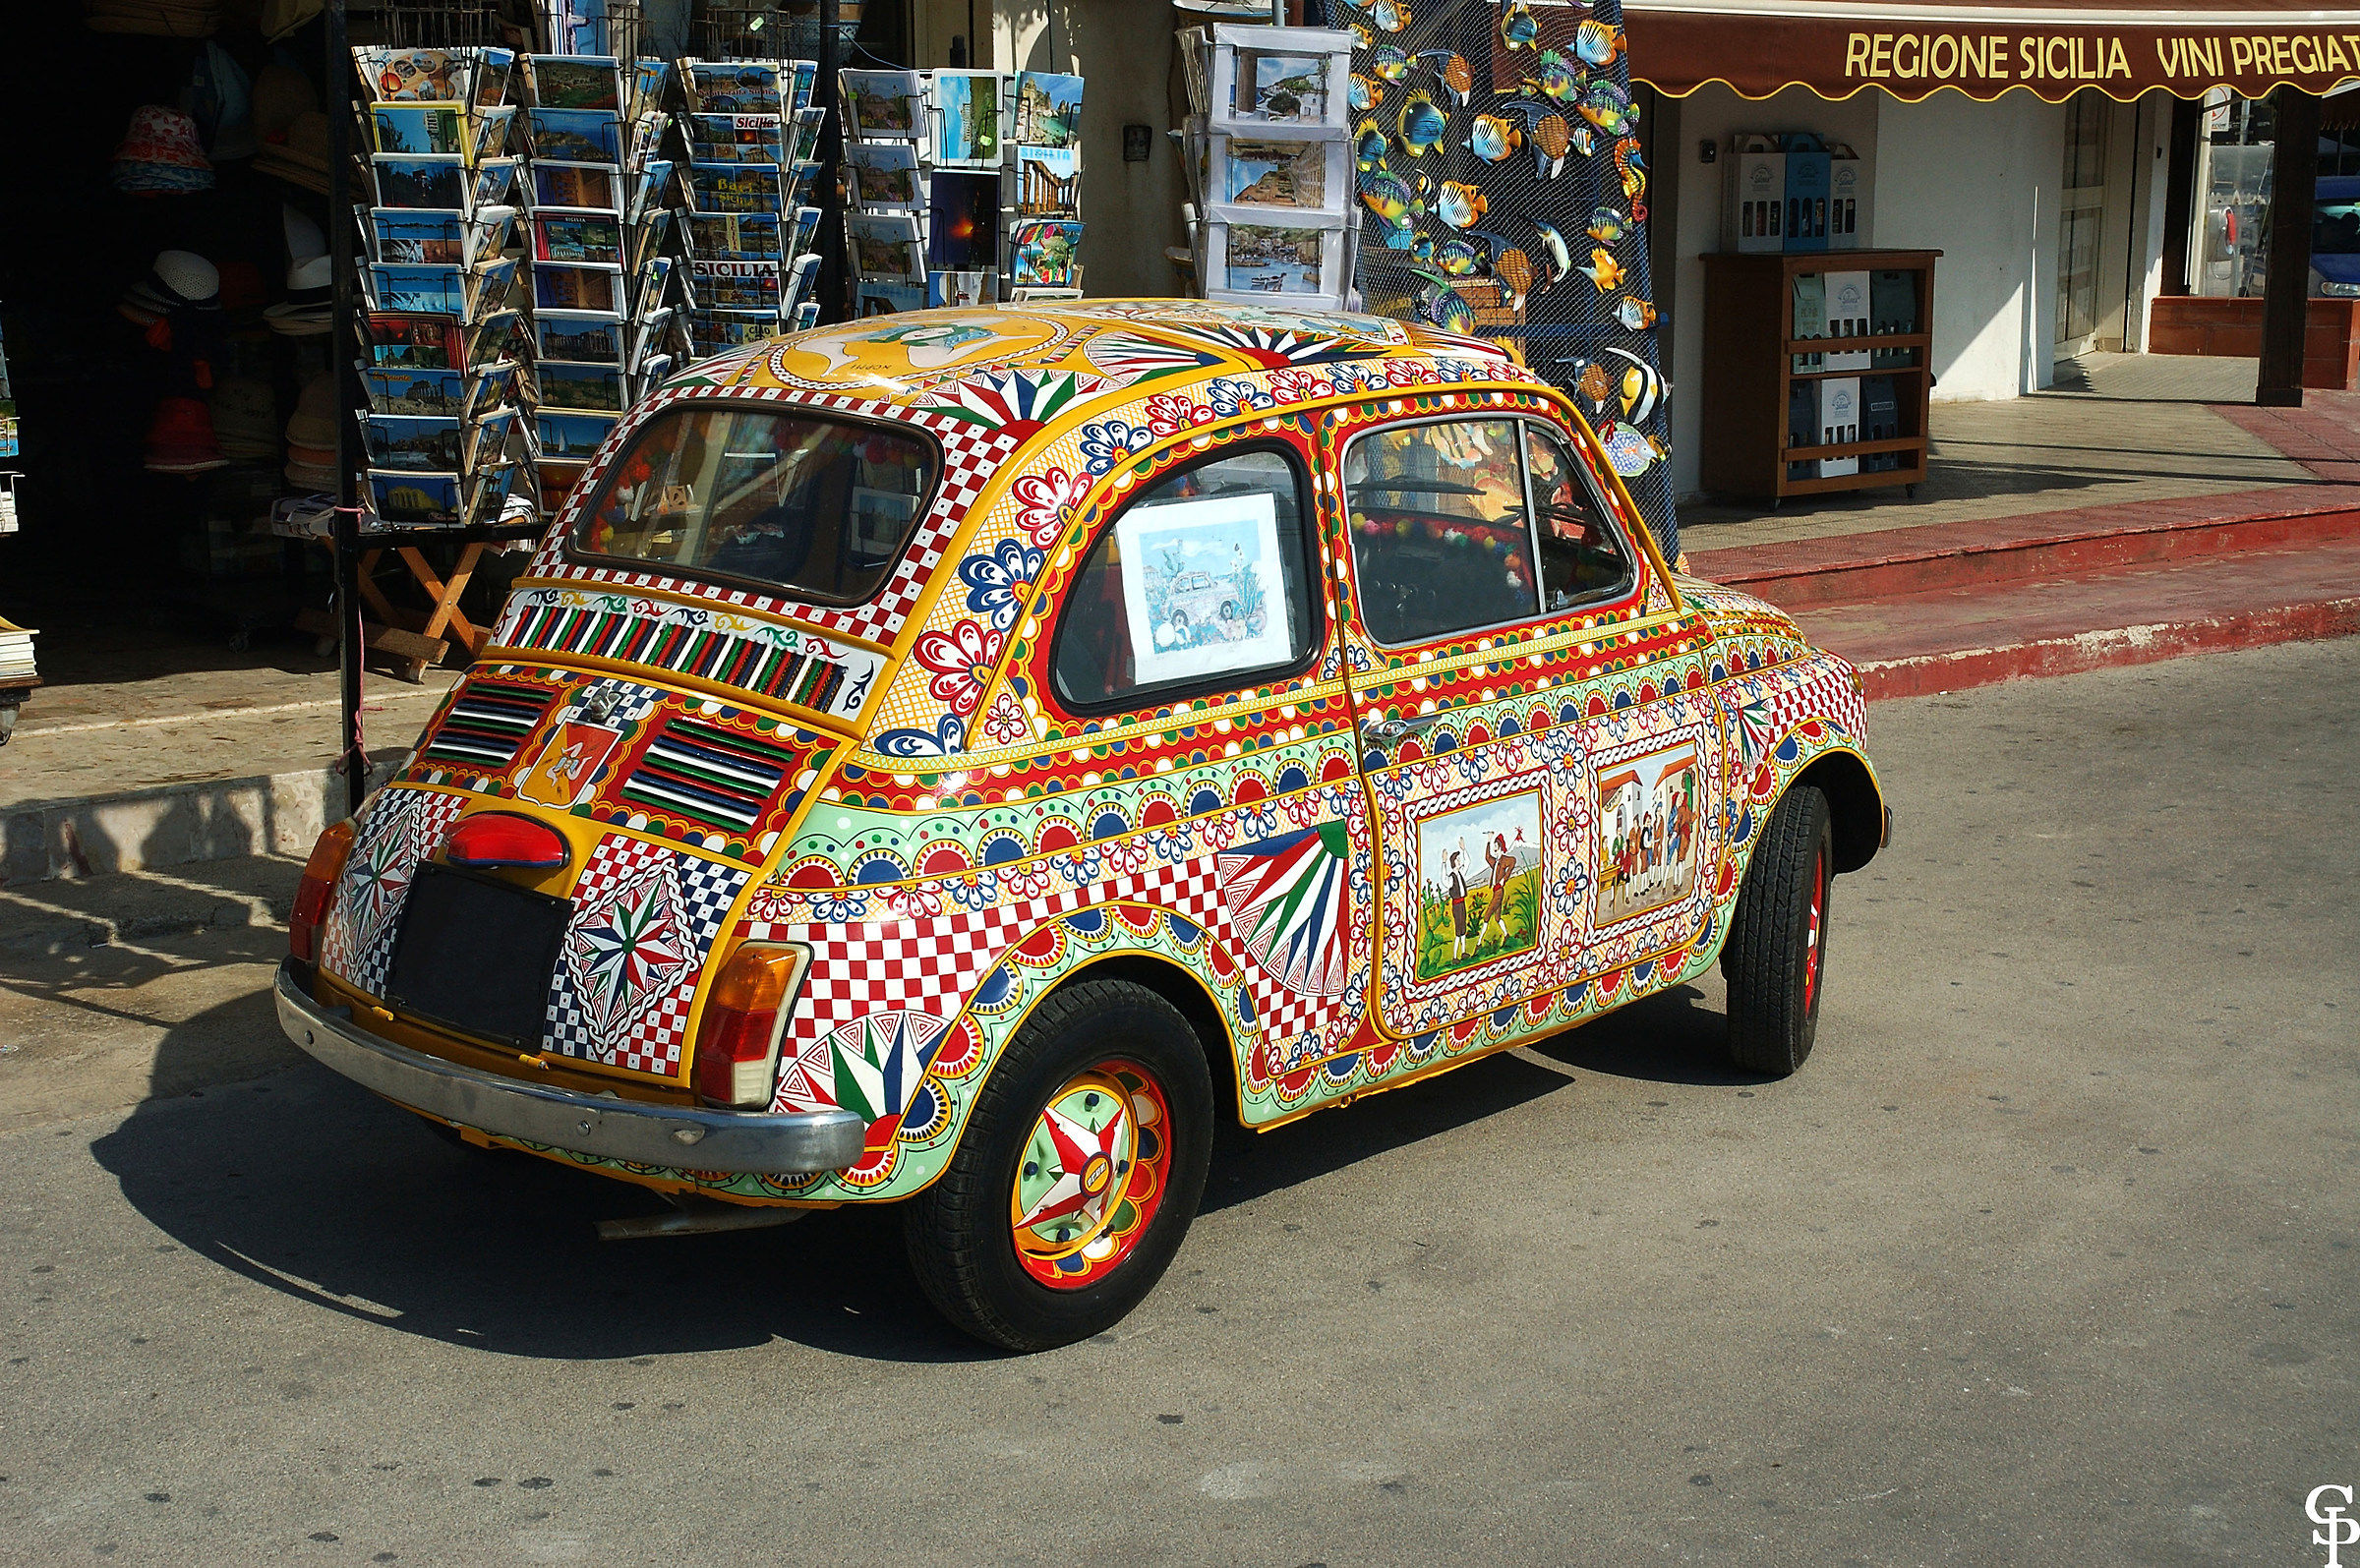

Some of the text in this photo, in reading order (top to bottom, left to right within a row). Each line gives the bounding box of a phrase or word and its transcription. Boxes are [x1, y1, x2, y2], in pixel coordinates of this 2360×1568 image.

[1845, 32, 2009, 79] REGIONE
[2019, 35, 2132, 80] SICILIA
[2156, 37, 2224, 78] VINI
[736, 117, 774, 128] Sicilia
[1020, 146, 1071, 160] SICILIA
[694, 261, 775, 276] SICILIA
